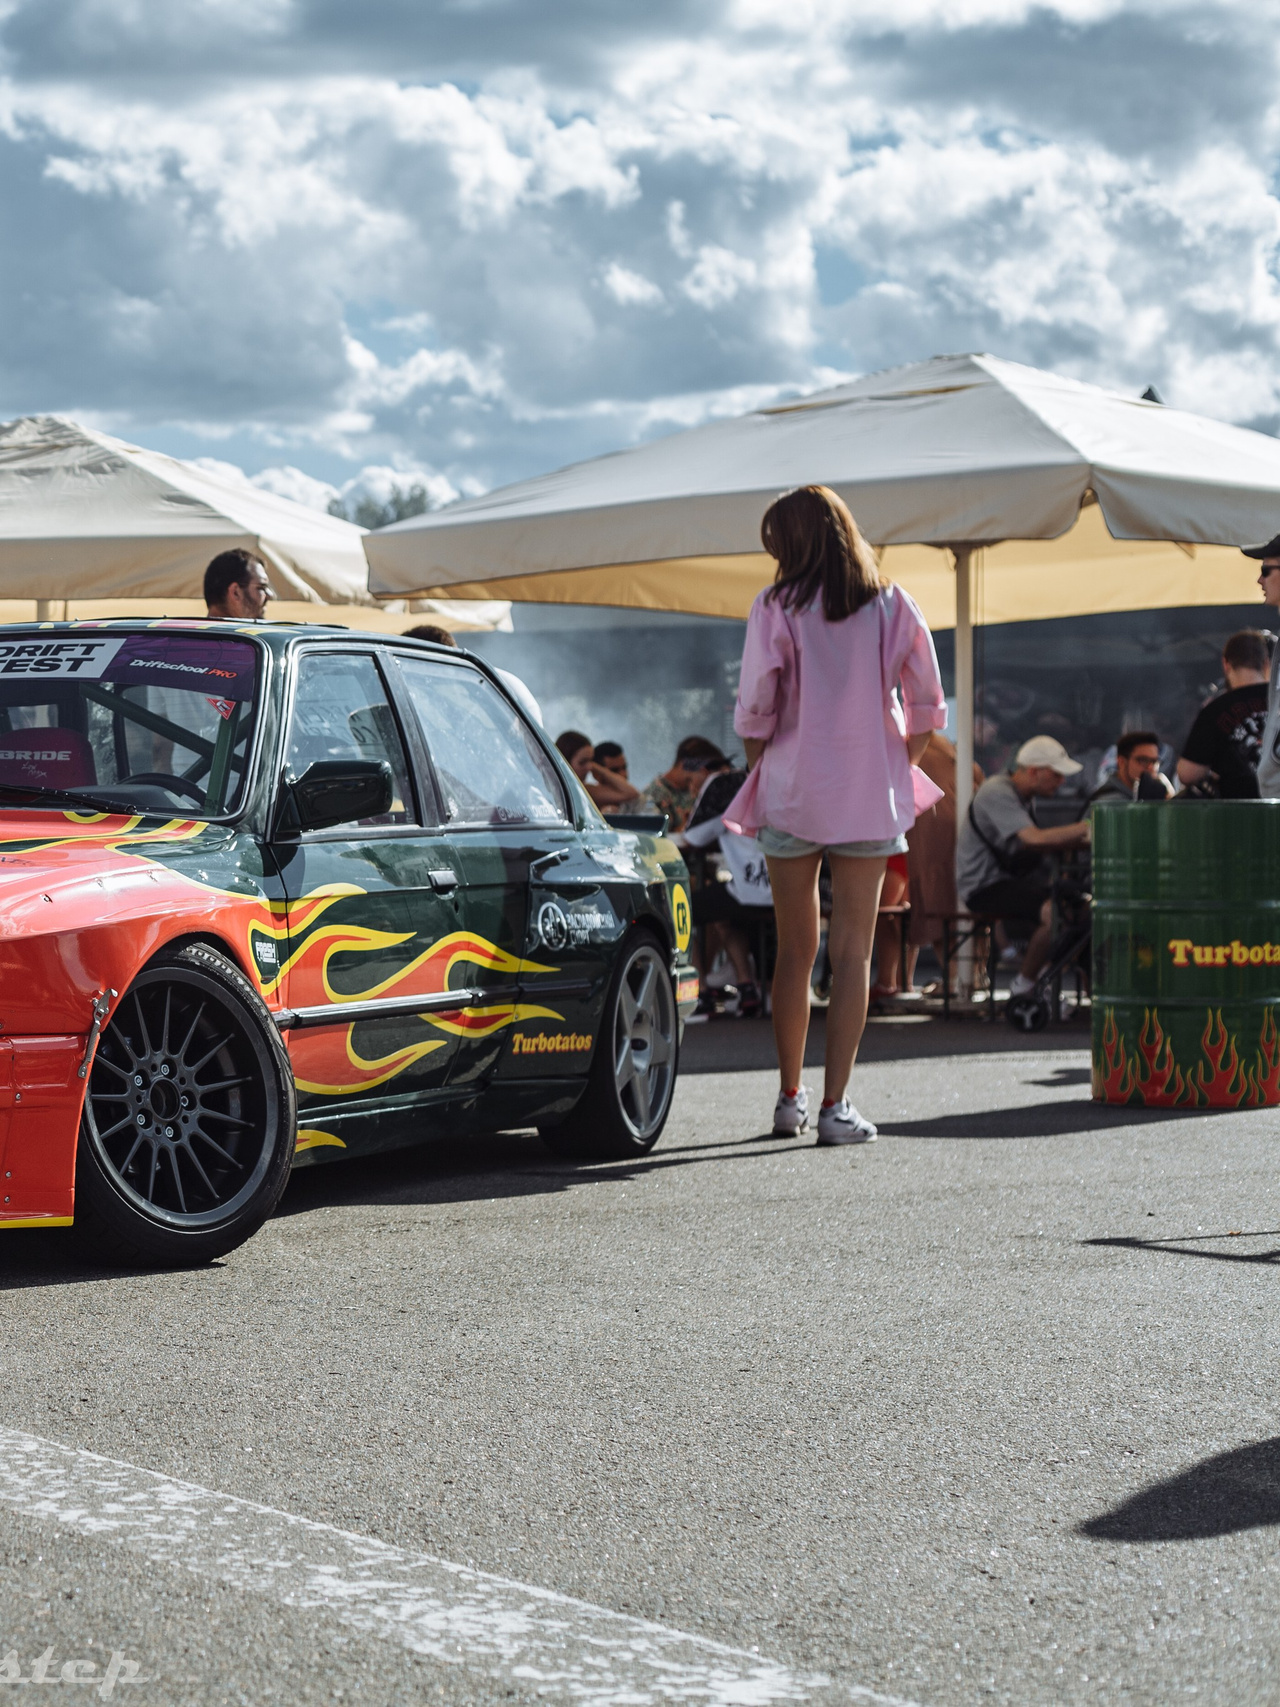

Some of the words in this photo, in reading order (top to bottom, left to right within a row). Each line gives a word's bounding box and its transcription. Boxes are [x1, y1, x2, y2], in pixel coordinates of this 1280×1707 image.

[129, 659, 238, 679] Driftschool.PRO
[676, 902, 689, 935] CR
[512, 1031, 593, 1055] Turbotatos
